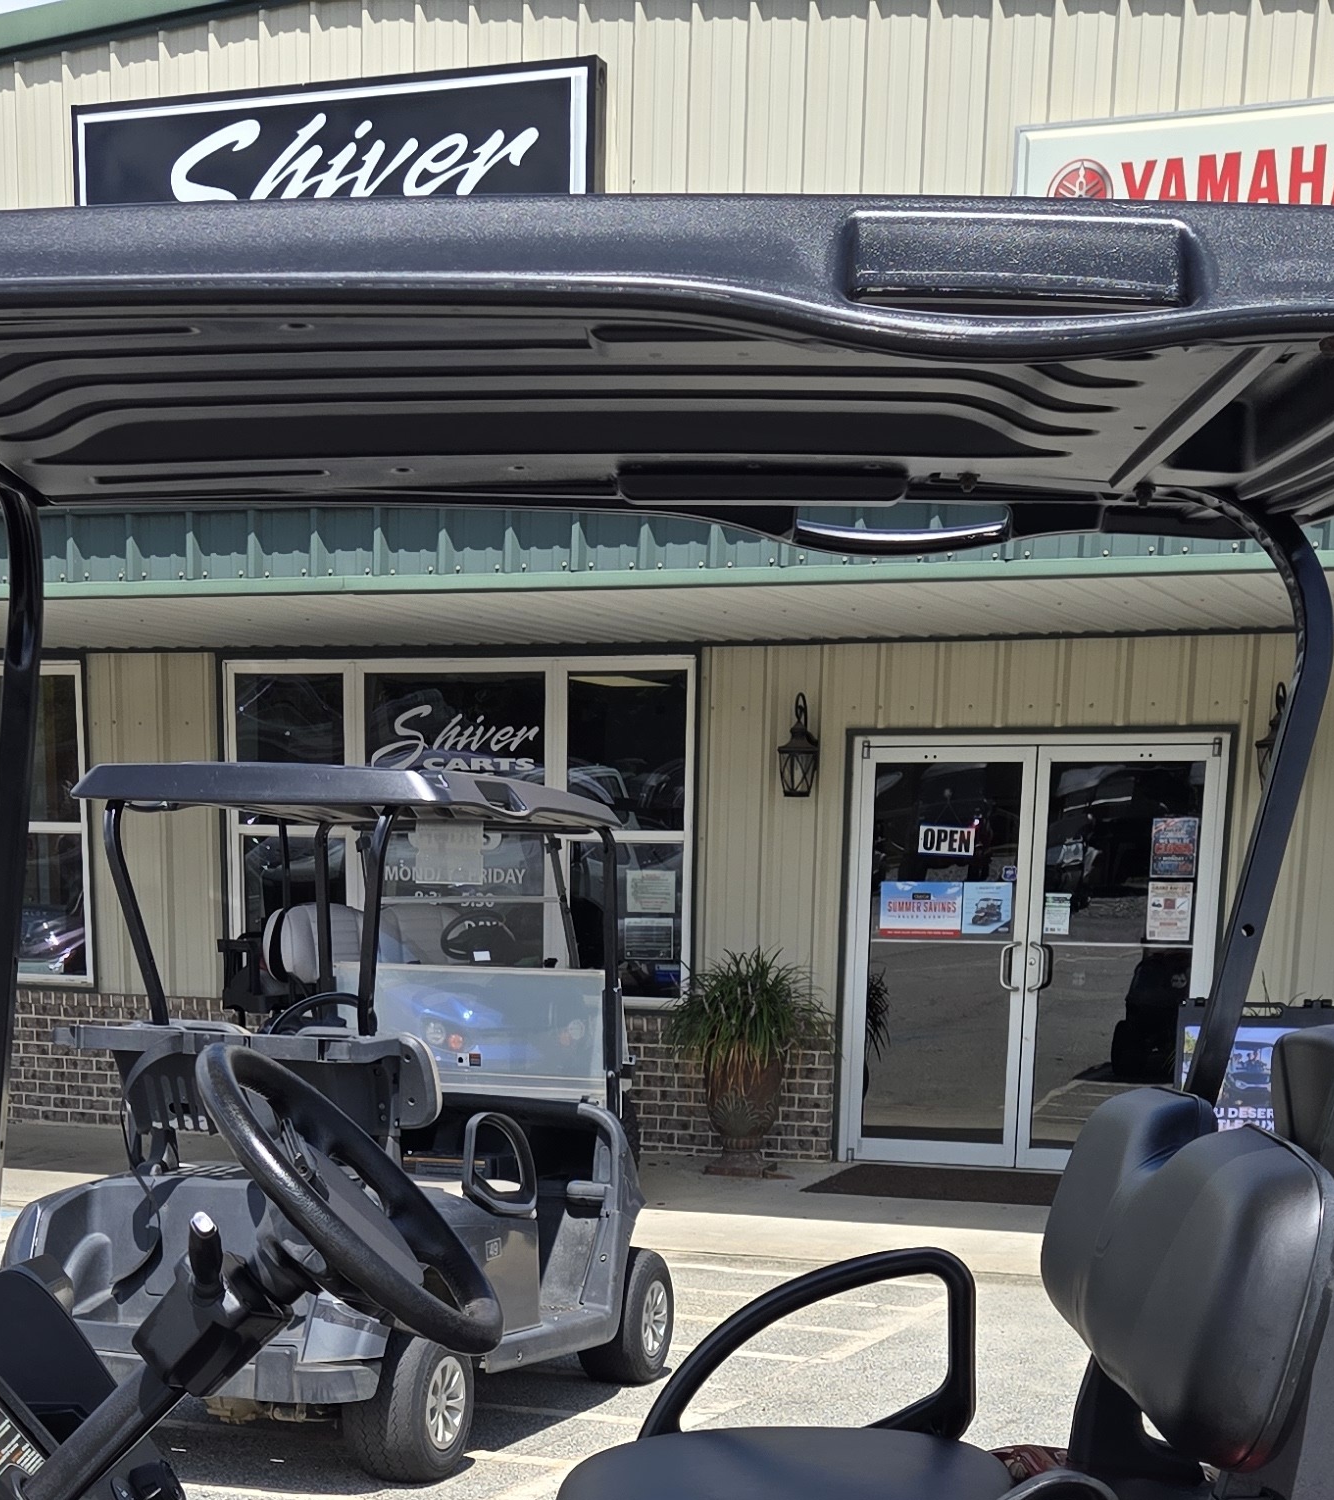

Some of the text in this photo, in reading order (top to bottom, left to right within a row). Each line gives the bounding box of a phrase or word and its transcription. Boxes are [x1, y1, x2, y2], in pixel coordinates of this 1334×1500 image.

[170, 112, 540, 202] Shiver
[371, 704, 540, 769] Shiver
[422, 757, 536, 771] CARTS
[922, 828, 971, 853] OPEN
[887, 901, 957, 913] SUMMER SAVINGS
[1228, 1106, 1274, 1119] DESER
